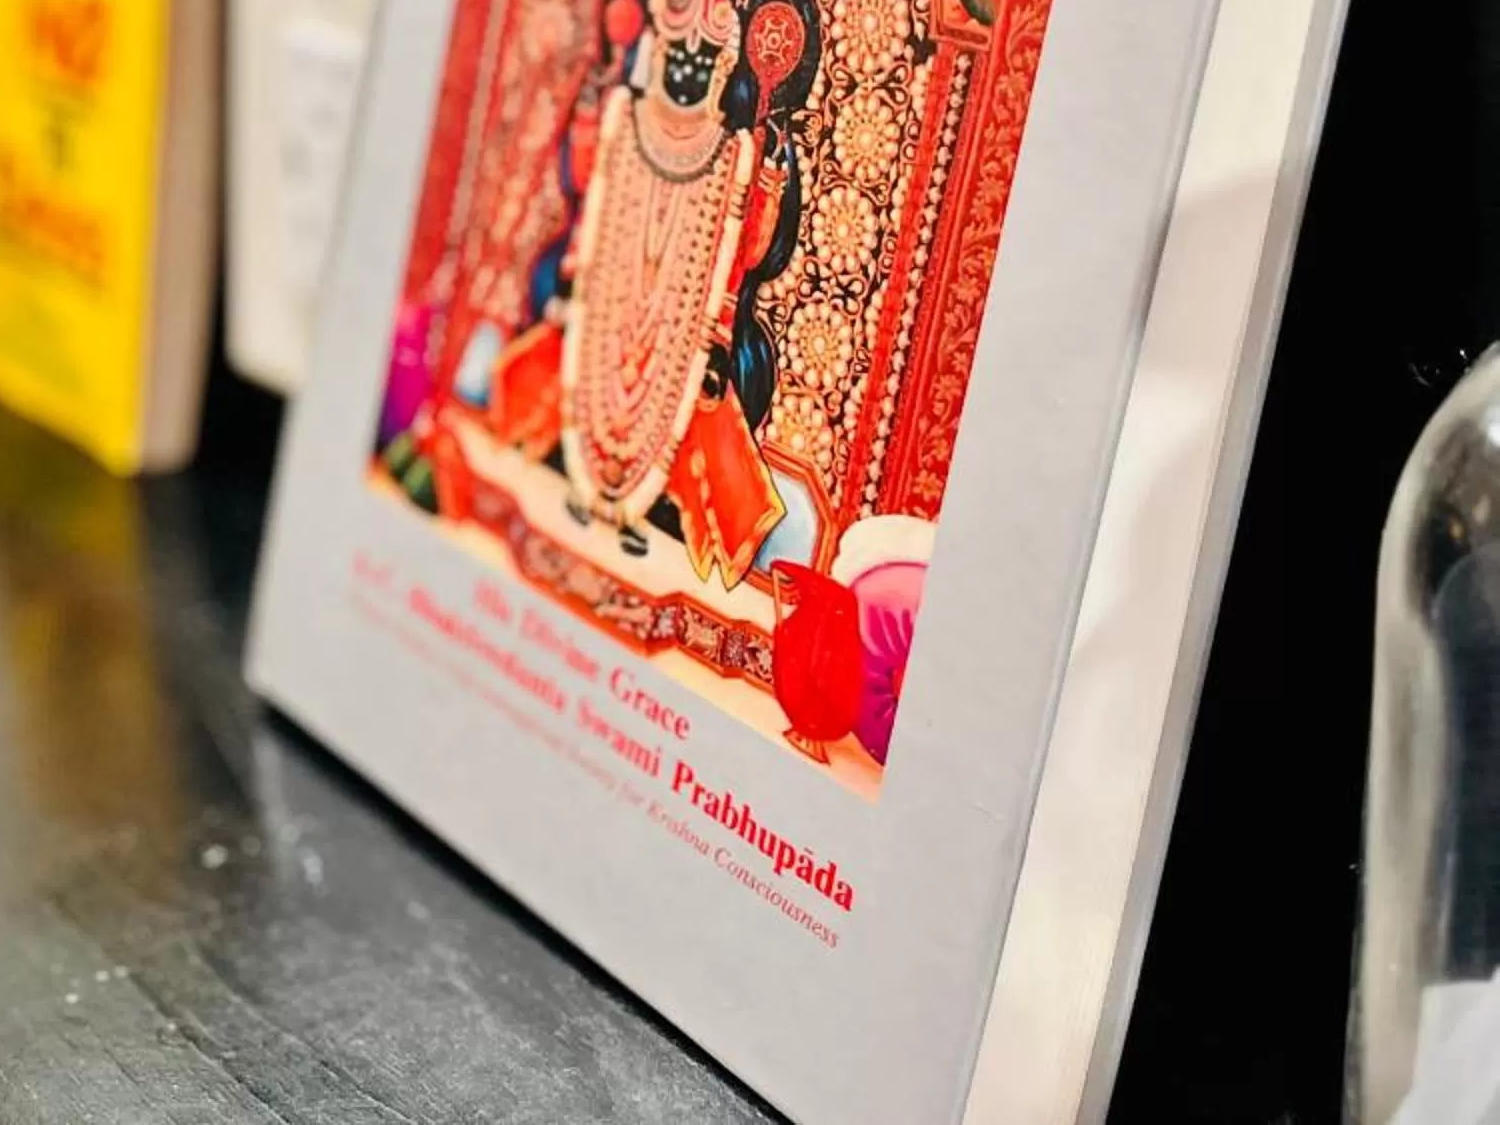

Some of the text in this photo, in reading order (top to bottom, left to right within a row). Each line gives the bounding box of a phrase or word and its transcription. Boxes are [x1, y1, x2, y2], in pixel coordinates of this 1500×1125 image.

[609, 666, 691, 741] Grace
[577, 703, 855, 913] Swami Prabhupāda
[714, 845, 840, 950] Consciousness
